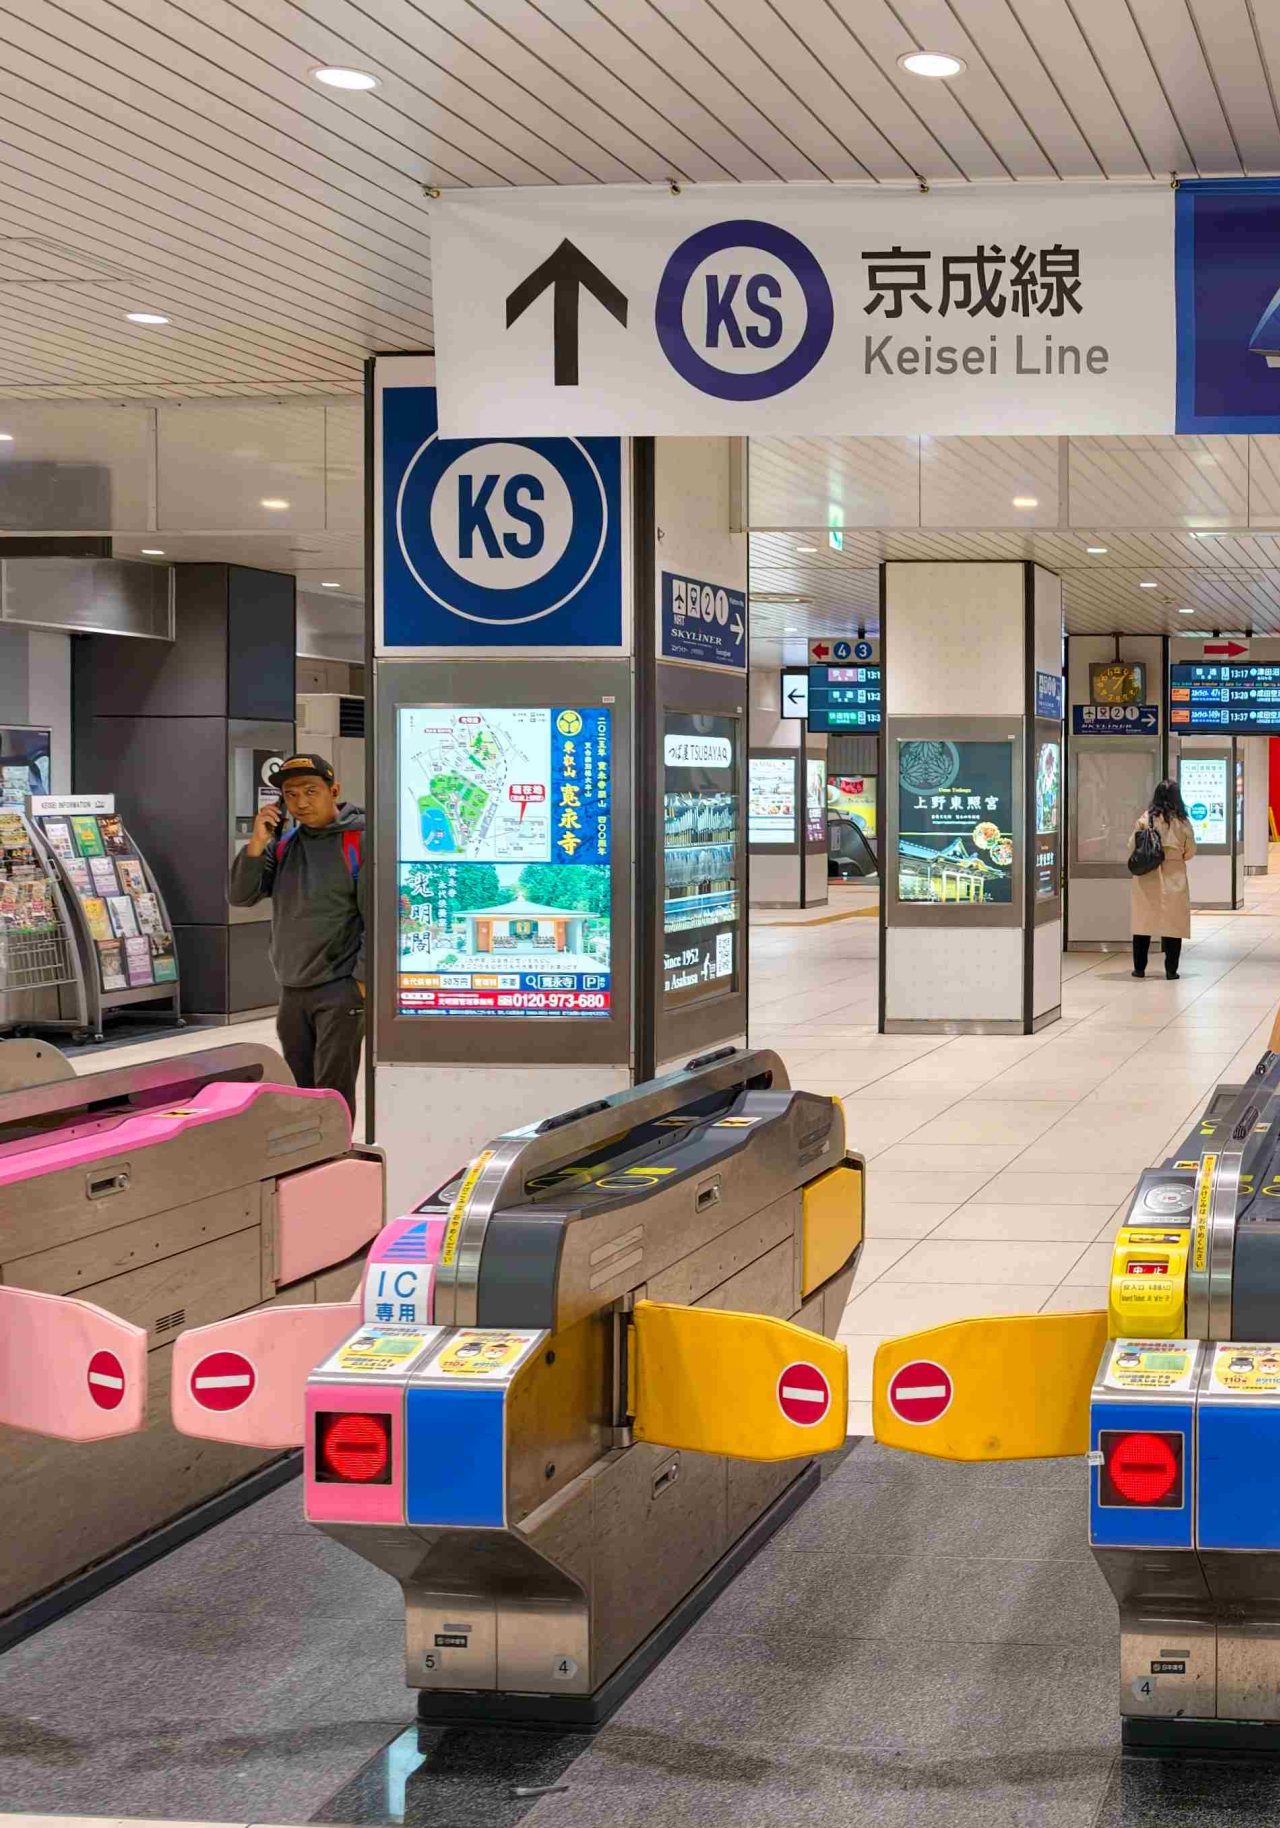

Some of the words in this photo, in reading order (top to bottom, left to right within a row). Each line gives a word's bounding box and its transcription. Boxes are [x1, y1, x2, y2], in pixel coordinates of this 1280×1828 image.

[862, 244, 1084, 318] 京成線
[705, 274, 783, 348] KS
[865, 335, 998, 375] Keisei
[1015, 335, 1109, 375] Line
[458, 473, 545, 559] KS
[1231, 670, 1248, 678] 13:17
[1231, 691, 1248, 700] 13:20
[1231, 713, 1248, 721] 13:37
[914, 796, 999, 810] 上野東照宮
[682, 948, 699, 966] 1952
[513, 994, 604, 1007] 0120-973-680
[378, 1270, 418, 1299] IC
[375, 1302, 415, 1322] 専用
[425, 1655, 435, 1668] 5
[558, 1660, 568, 1674] 4
[1141, 1682, 1150, 1695] 4
